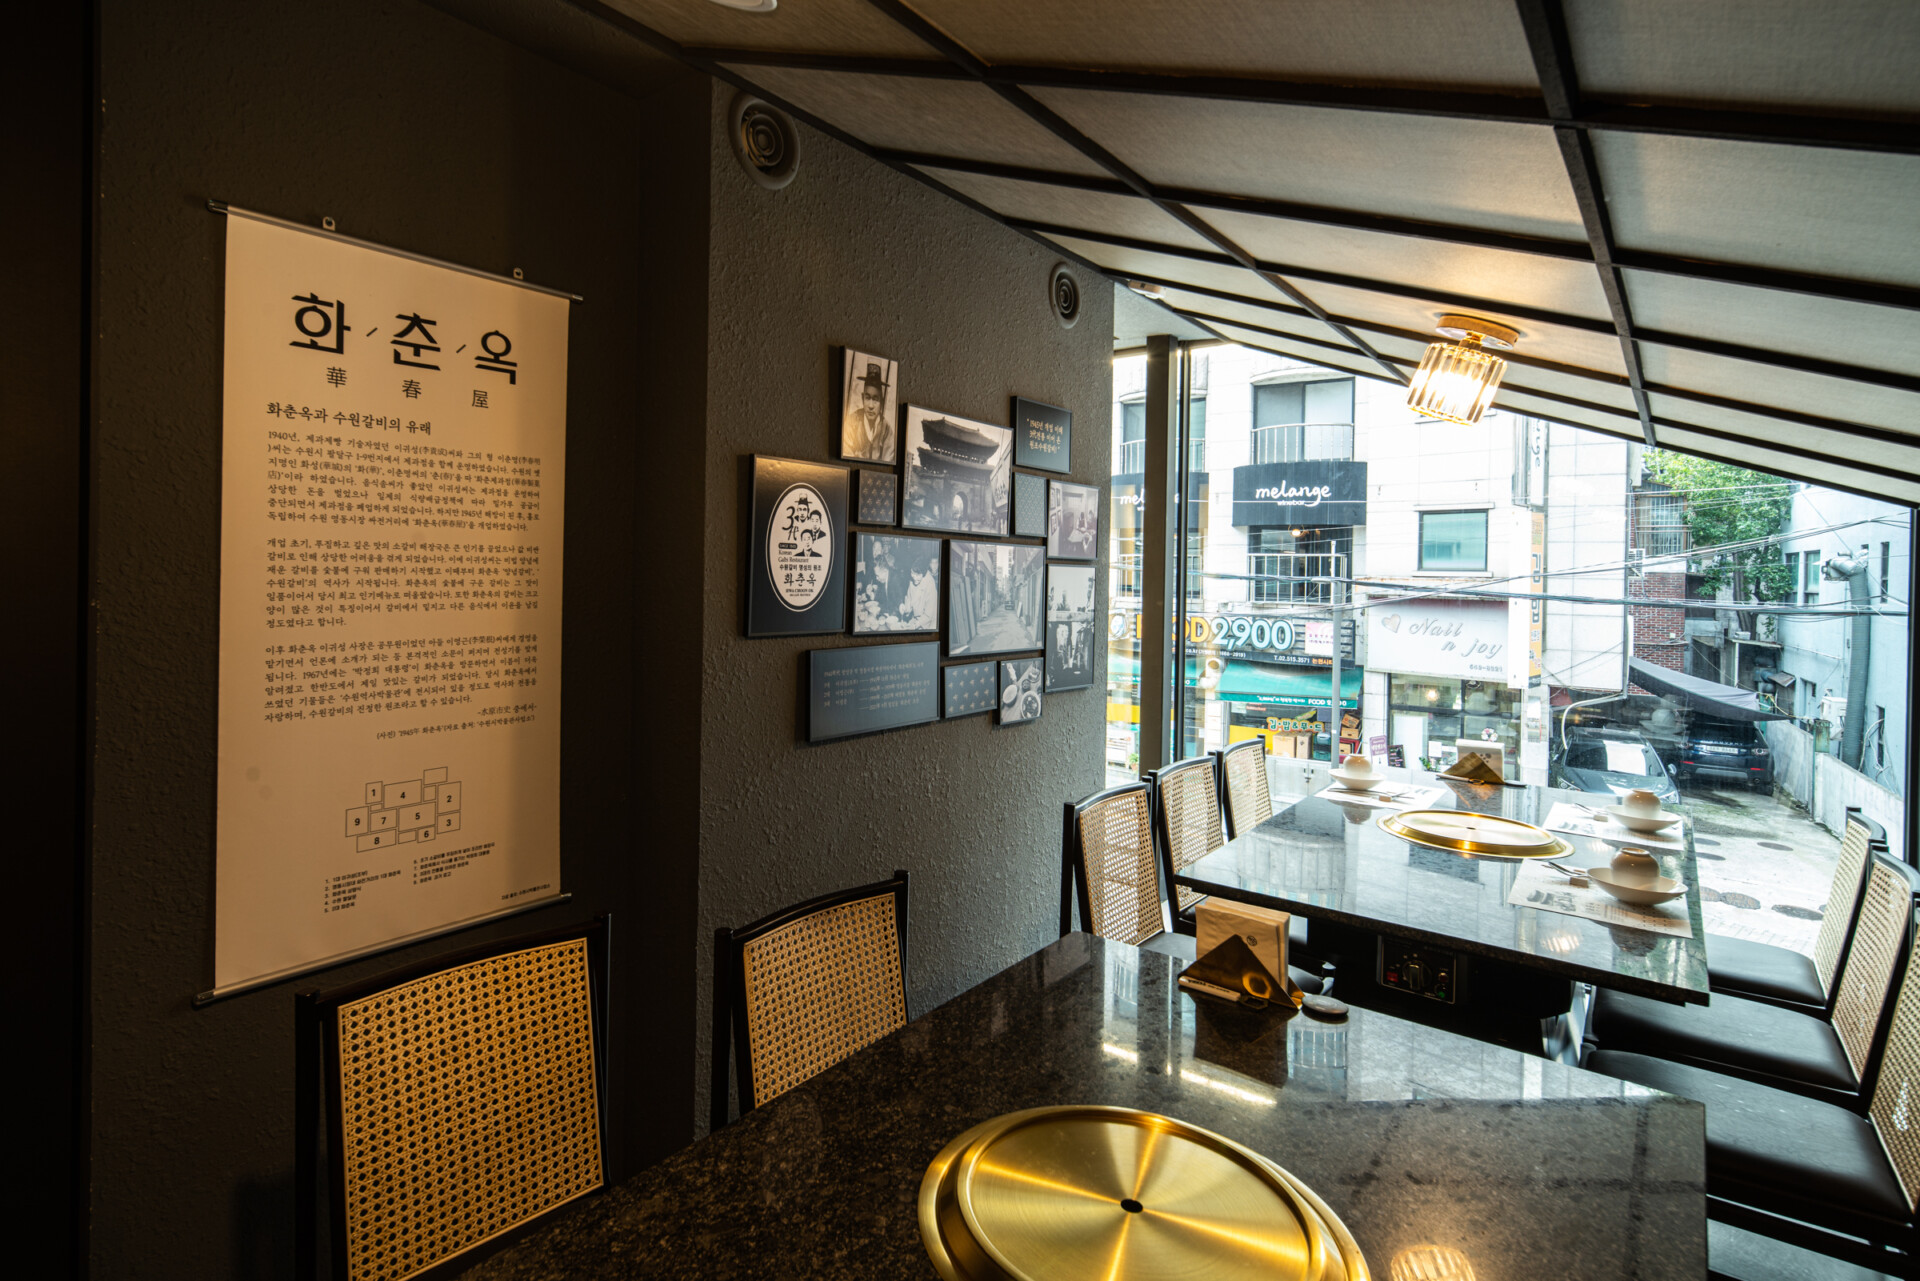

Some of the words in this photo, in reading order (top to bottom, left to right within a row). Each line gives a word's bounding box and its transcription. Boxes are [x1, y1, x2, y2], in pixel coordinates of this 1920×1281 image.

[266, 402, 329, 423] 화춘옥과
[333, 411, 400, 431] 수원갈비의
[406, 420, 431, 435] 유래
[306, 434, 342, 447] 제과제빵
[348, 439, 389, 452] 기술자였던
[467, 452, 481, 460] 그의
[269, 457, 297, 468] 지명인
[295, 447, 323, 457] 수원시
[327, 449, 353, 460] 팔달구
[404, 457, 435, 468] 제과점을
[310, 474, 356, 486] 하였습니다.
[481, 487, 509, 497] 제과점을
[268, 484, 297, 495] 상당한
[307, 487, 325, 497] 돈을
[334, 489, 368, 499] 벌었으나
[377, 492, 401, 501] 일제의
[1255, 481, 1331, 507] melange
[268, 498, 315, 509] 중단되면서
[319, 501, 354, 511] 제과점을
[357, 503, 389, 513] 폐업하게
[392, 505, 434, 515] 되었습니다.
[267, 512, 306, 522] 독립하여
[310, 514, 327, 523] 수원
[331, 514, 366, 525] 영동시장
[267, 538, 286, 548] 개업
[315, 540, 350, 549] 푸짐하고
[354, 541, 370, 550] 깊은
[373, 541, 389, 550] 맛의
[392, 542, 416, 551] 소갈비
[453, 544, 460, 552] 큰
[267, 551, 296, 561] 갈비로
[299, 552, 317, 562] 인해
[321, 553, 347, 562] 상당한
[350, 553, 384, 563] 어려움을
[387, 554, 402, 563] 겪게
[405, 554, 446, 563] 되었습니다.
[449, 555, 463, 564] 이에
[267, 565, 286, 575] 재운
[291, 565, 319, 575] 갈비를
[323, 566, 349, 575] 숯불에
[353, 566, 370, 575] 구워
[374, 566, 406, 575] 판매하기
[411, 566, 442, 575] 시작했고
[323, 578, 350, 588] 역사가
[356, 578, 400, 588] 시작됩니다.
[784, 572, 816, 587] 화춘옥
[266, 592, 314, 602] 일품이어서
[318, 592, 335, 601] 당시
[339, 591, 356, 600] 최고
[359, 591, 401, 600] 인기메뉴로
[455, 590, 470, 599] 또한
[266, 605, 285, 615] 양이
[291, 605, 310, 614] 많은
[316, 604, 333, 614] 것이
[338, 603, 380, 613] 특징이어서
[386, 603, 417, 612] 갈비에서
[266, 618, 314, 629] 정도였다고
[318, 617, 346, 627] 합니다.
[1409, 618, 1464, 637] Nail
[1211, 617, 1294, 650] 2,900
[266, 645, 285, 655] 이후
[288, 644, 317, 654] 화춘옥
[320, 642, 346, 652] 이귀성
[349, 641, 375, 651] 사장은
[1441, 640, 1456, 651] n
[1461, 638, 1503, 659] joy
[265, 658, 303, 669] 맡기면서
[309, 656, 336, 667] 언론에
[342, 654, 368, 664] 소개가
[372, 653, 389, 662] 되는
[265, 671, 297, 683] 됩니다.
[265, 685, 304, 696] 알려졌고
[310, 680, 354, 692] 한반도에서
[361, 678, 377, 688] 제일
[383, 677, 408, 686] 맛있는
[413, 674, 437, 684] 갈비가
[441, 671, 480, 682] 되었습니다.
[264, 698, 293, 709] 쓰였던
[309, 705, 353, 718] 수원갈비의
[357, 703, 382, 714] 진정한
[385, 700, 417, 711] 원조라고
[430, 698, 438, 706] 수
[440, 695, 472, 705] 있습니다.
[371, 789, 376, 797] 1
[446, 795, 452, 803] 2
[354, 818, 361, 826] 9
[381, 816, 387, 825] 7
[415, 812, 421, 820] 5
[446, 819, 452, 827] 3
[424, 830, 430, 838] 6
[374, 837, 380, 845] 8
